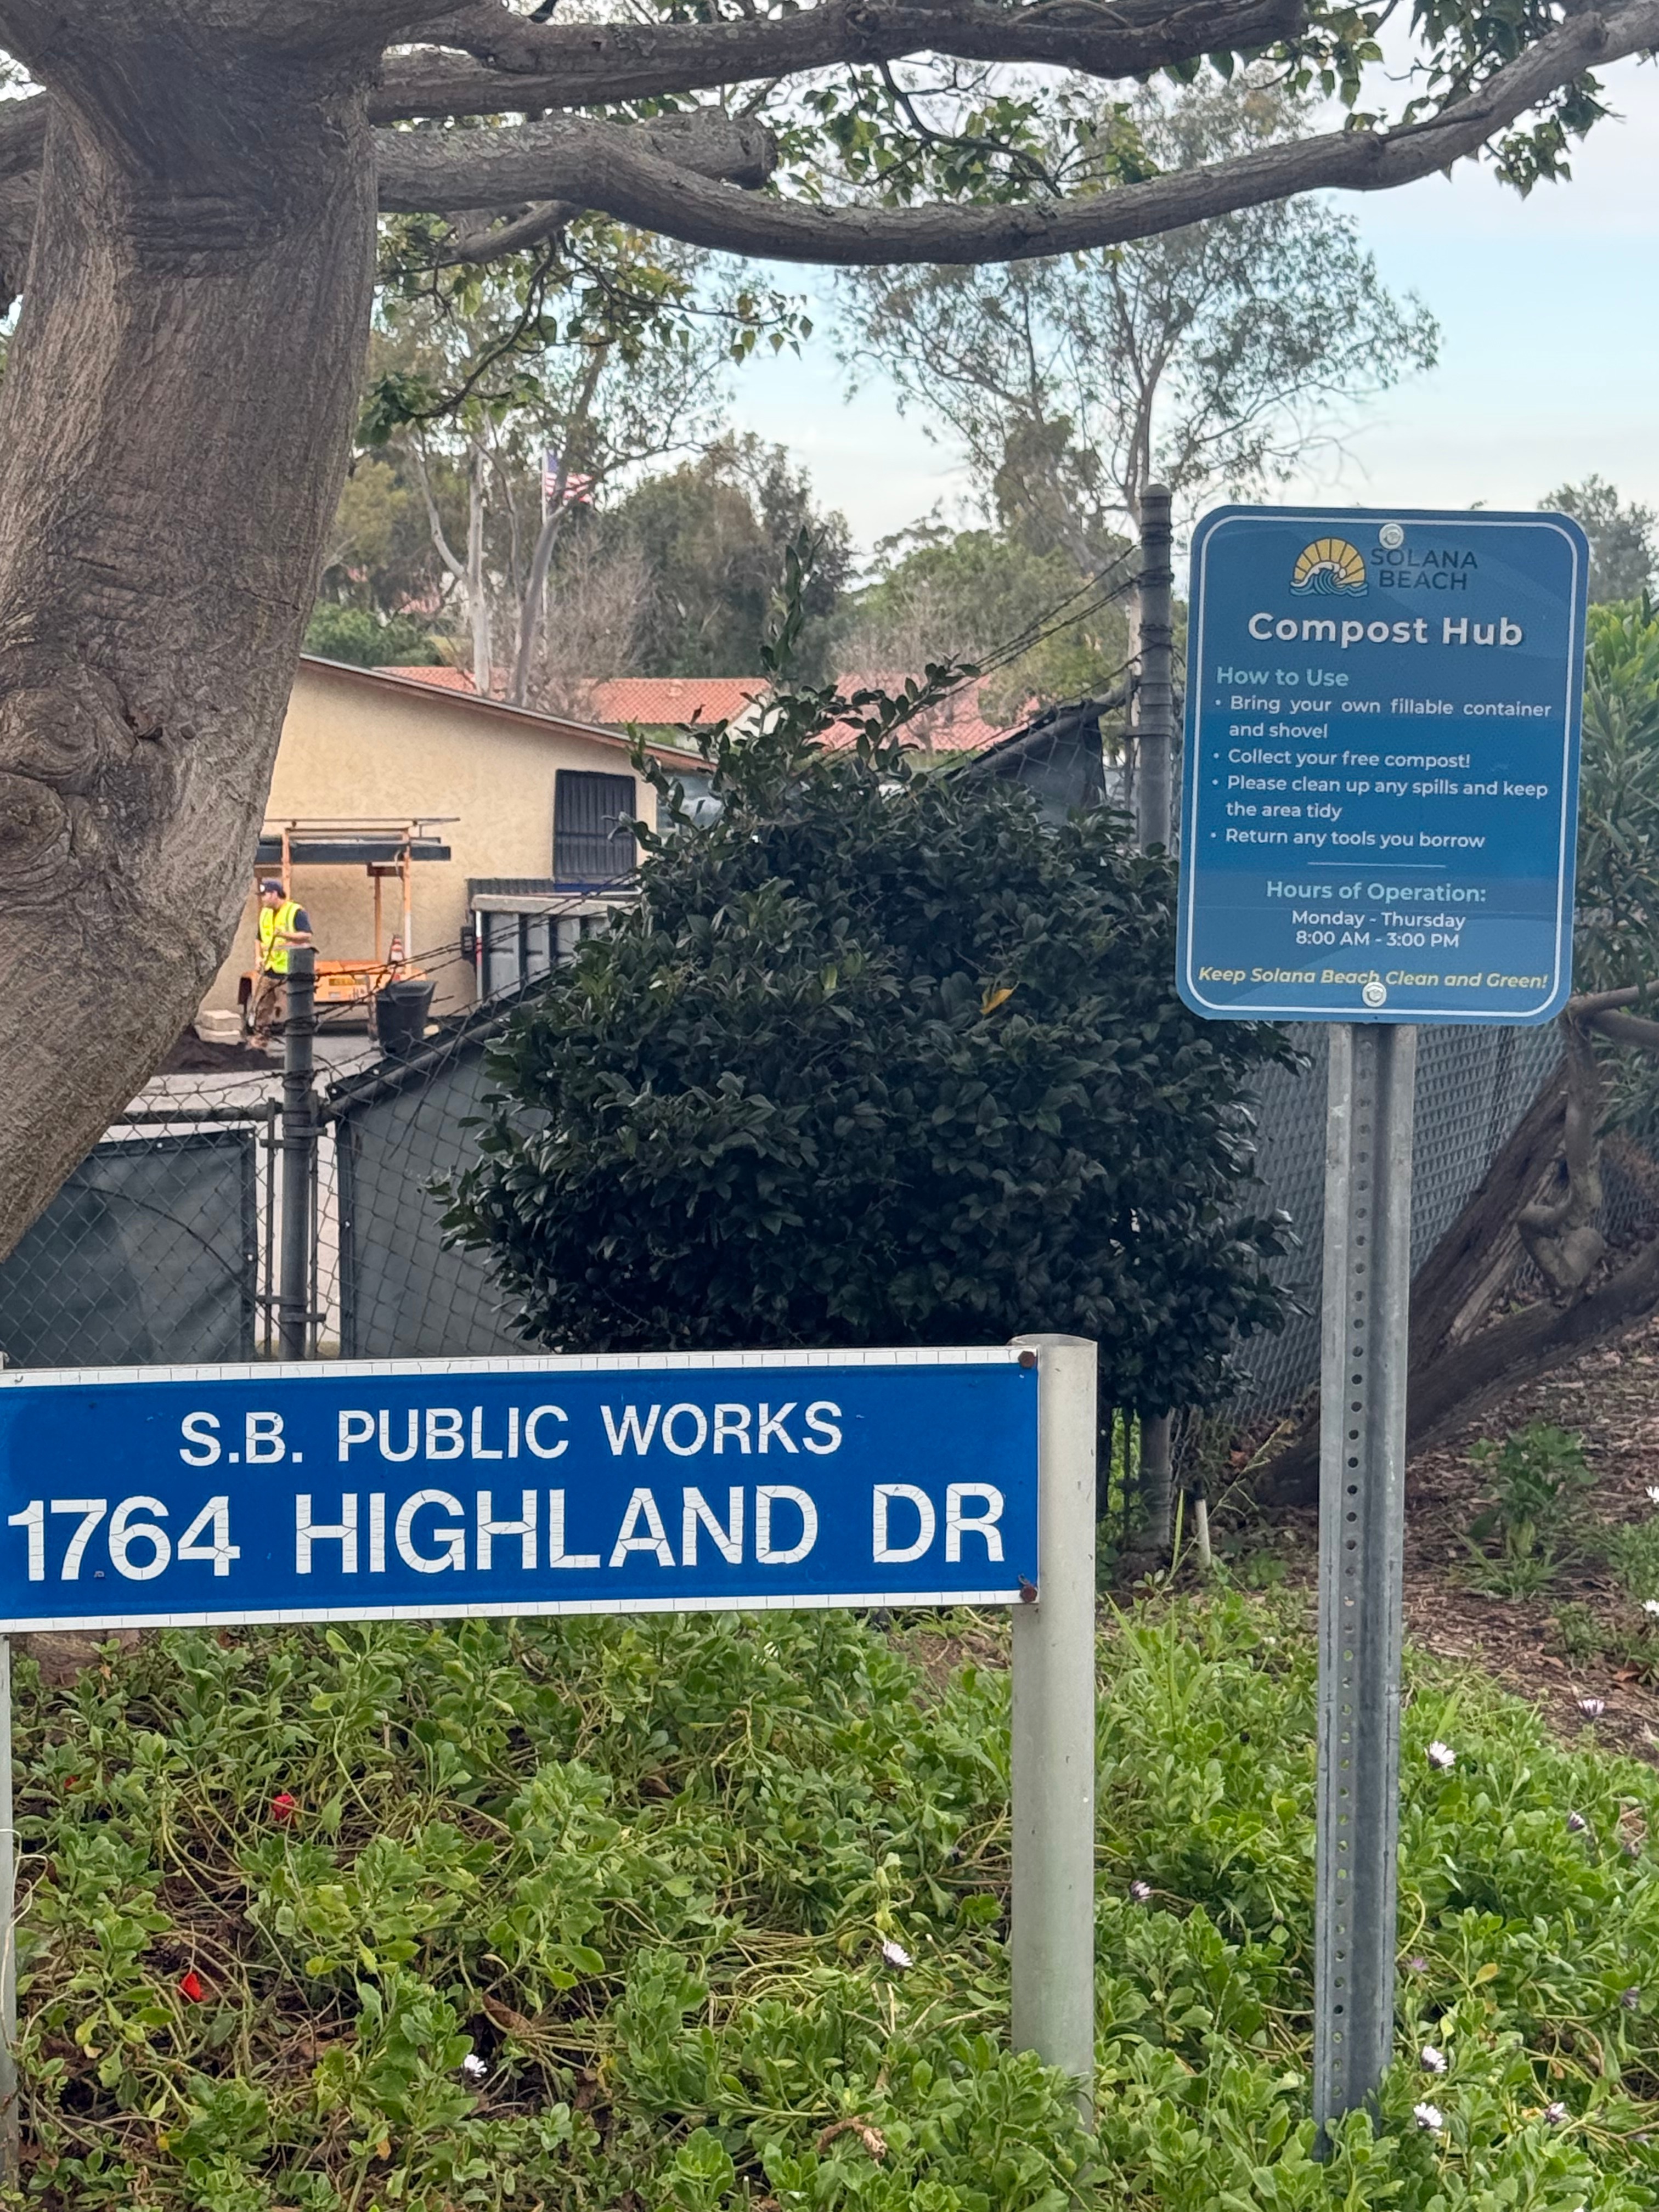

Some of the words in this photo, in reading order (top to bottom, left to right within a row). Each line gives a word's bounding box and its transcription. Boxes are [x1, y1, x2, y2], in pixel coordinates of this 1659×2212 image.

[1371, 549, 1478, 569] SOLANA
[1379, 571, 1467, 590] BEACH
[1248, 612, 1427, 648] Compost
[1442, 617, 1522, 646] Hub
[1217, 667, 1269, 685] How
[1276, 669, 1299, 685] to
[1307, 669, 1349, 686] Use
[1231, 695, 1280, 713] Bring
[1289, 700, 1331, 714] your
[1341, 701, 1380, 713] own
[1391, 698, 1453, 714] fillable
[1463, 701, 1551, 716] container
[1229, 723, 1263, 737] and
[1269, 723, 1328, 738] shovel
[1228, 749, 1291, 764] Collect
[1295, 753, 1337, 768] your
[1342, 751, 1379, 766] free
[1384, 754, 1471, 770] compost!
[1228, 775, 1286, 791] Please
[1292, 776, 1340, 792] clean
[1346, 781, 1370, 795] up
[1374, 781, 1408, 797] any
[1412, 778, 1458, 797] spills
[1463, 781, 1498, 795] and
[1503, 781, 1548, 799] keep
[1226, 801, 1256, 816] the
[1261, 805, 1301, 817] area
[1306, 803, 1343, 822] tidy
[1226, 828, 1288, 844] Return
[1293, 832, 1327, 848] any
[1331, 831, 1375, 845] tools
[1379, 834, 1413, 849] you
[1420, 832, 1486, 848] borrow
[1266, 881, 1332, 899] Hours
[1338, 882, 1363, 900] of
[1367, 883, 1486, 904] Operation:
[1292, 910, 1365, 929] Monday
[1381, 911, 1466, 931] Thursday
[1295, 930, 1335, 945] 8:00
[1339, 932, 1369, 946] AM
[1386, 933, 1425, 947] 3:00
[1431, 934, 1459, 948] PM
[1198, 967, 1246, 984] Keep
[1250, 968, 1316, 984] Solana
[1320, 969, 1380, 984] Beach
[1386, 970, 1439, 986] Clean
[1444, 973, 1482, 986] and
[1487, 973, 1548, 989] Green!
[179, 1411, 303, 1467] S.B.
[337, 1406, 569, 1463] PUBLIC
[600, 1400, 843, 1457] WORKS
[8, 1494, 241, 1582] 1764
[296, 1484, 818, 1574] HIGHLAND
[873, 1482, 1005, 1564] DR
